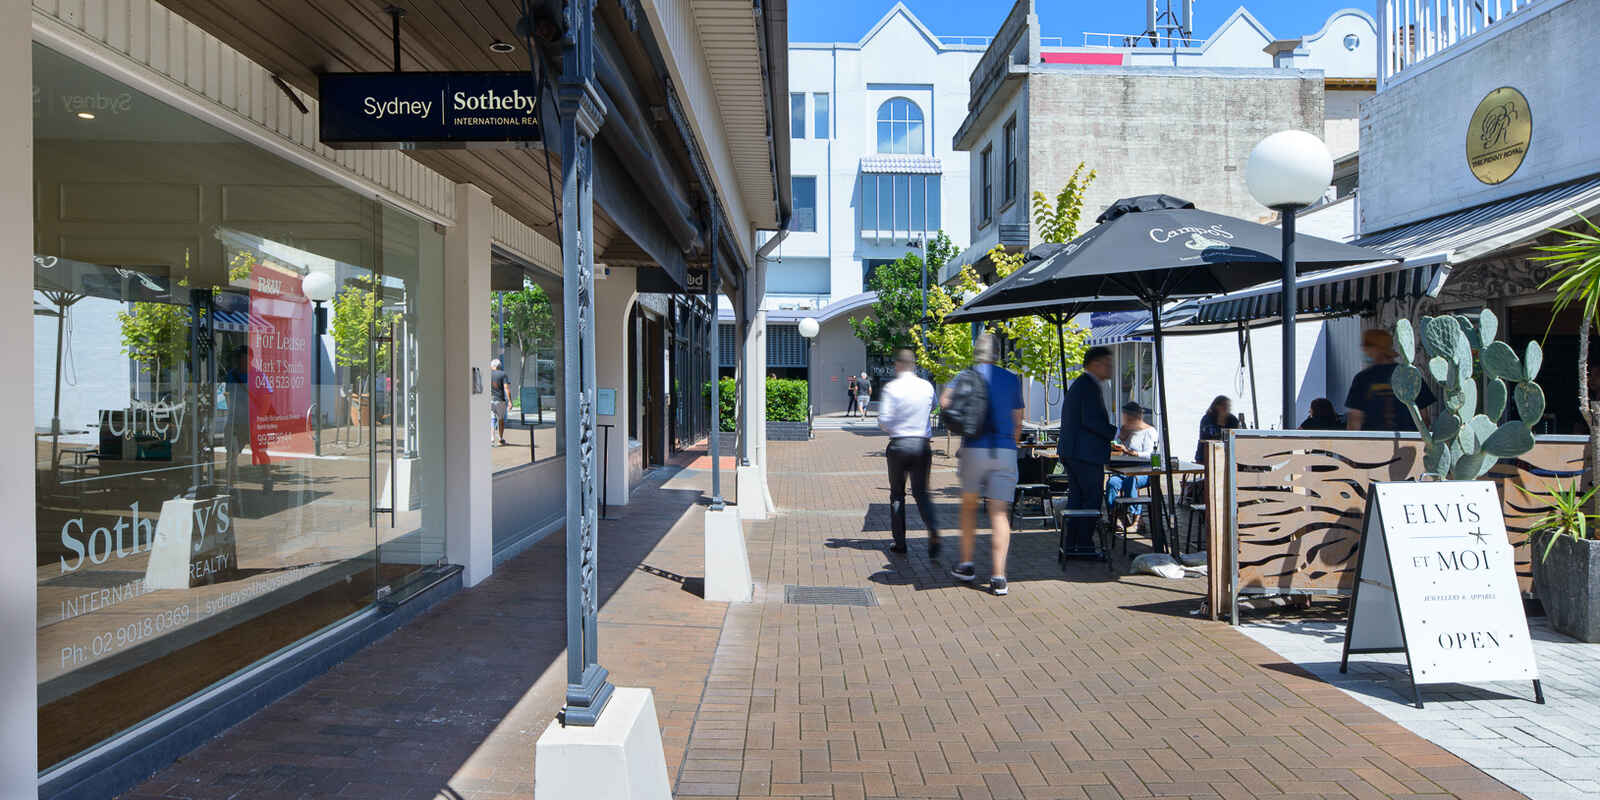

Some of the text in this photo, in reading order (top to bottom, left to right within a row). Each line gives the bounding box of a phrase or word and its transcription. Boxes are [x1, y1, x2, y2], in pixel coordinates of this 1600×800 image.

[363, 96, 432, 119] Sydney
[454, 117, 520, 126] INTERNATIONAL
[1503, 148, 1523, 157] ROYAL
[255, 329, 306, 352] For Lease
[255, 359, 275, 374] Mark
[1403, 503, 1480, 524] ELVIS
[188, 552, 230, 580] REALTY
[1412, 550, 1490, 571] ET MOI
[60, 643, 88, 669] Ph:
[92, 631, 113, 656] 02
[116, 617, 153, 646] 9018
[155, 605, 190, 630] 0369
[1437, 631, 1501, 649] OPEN
